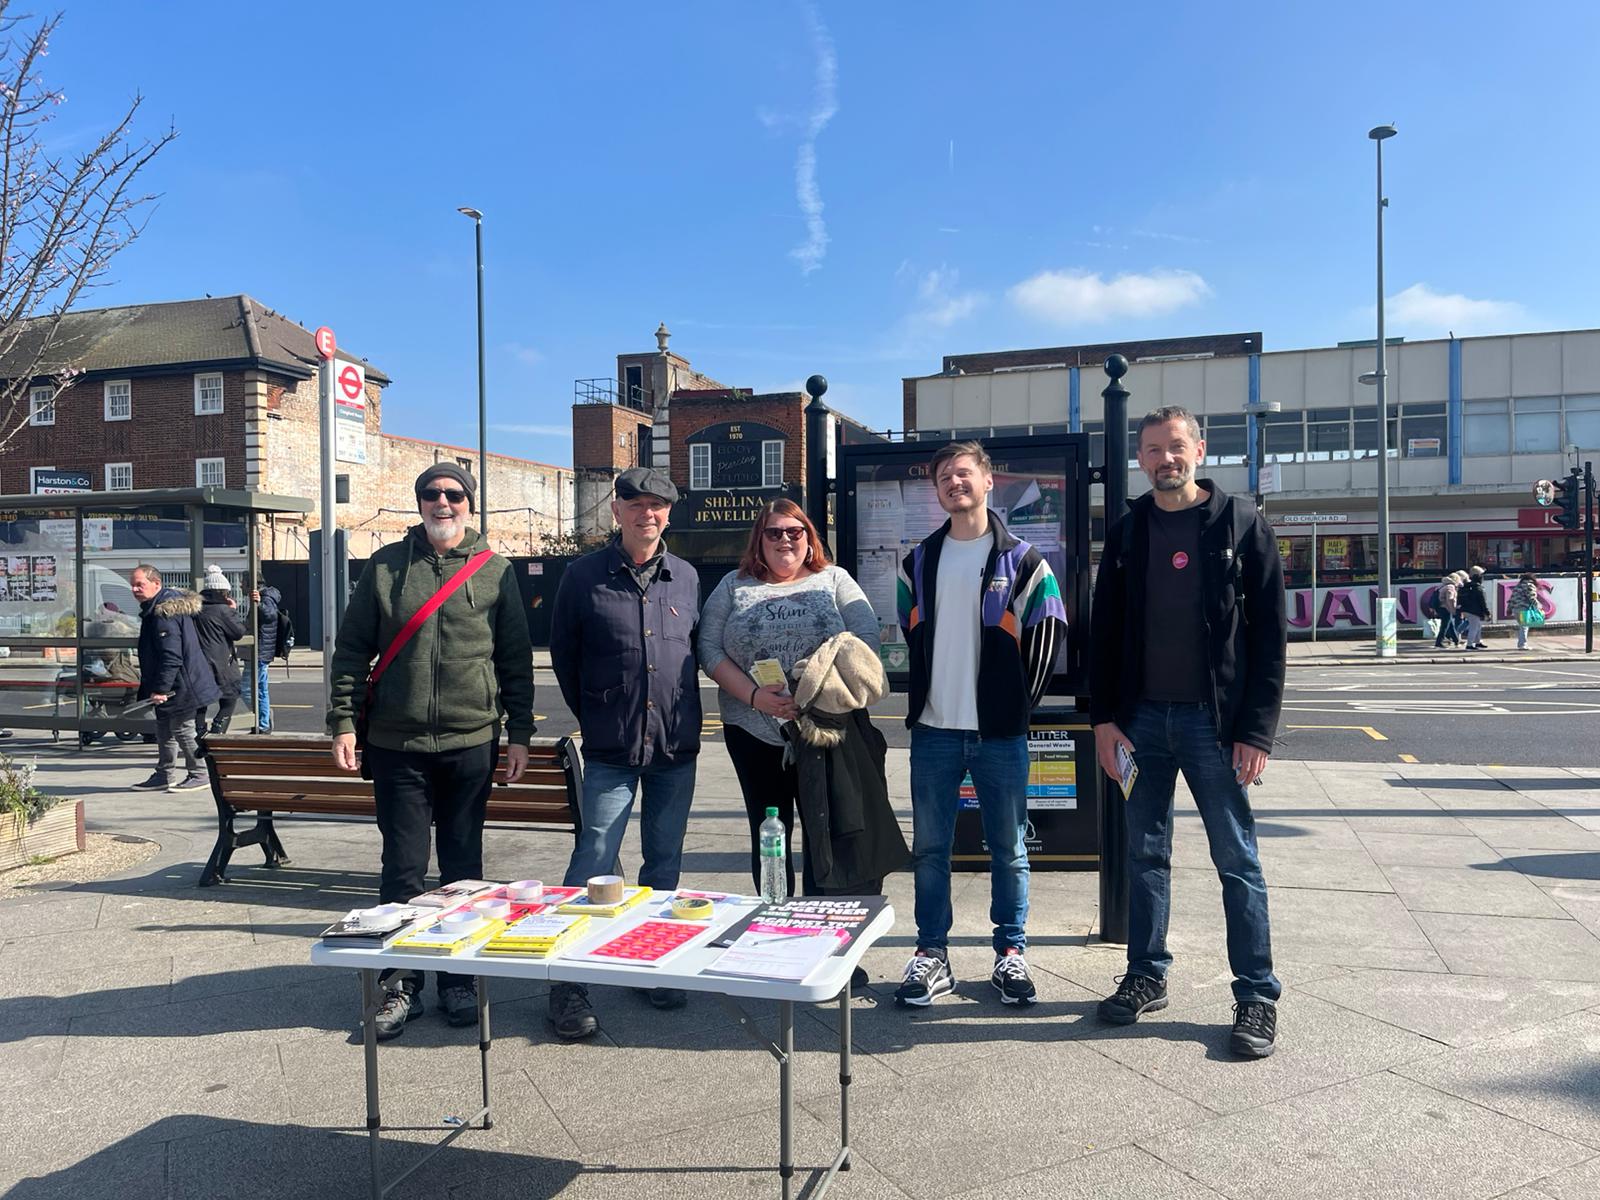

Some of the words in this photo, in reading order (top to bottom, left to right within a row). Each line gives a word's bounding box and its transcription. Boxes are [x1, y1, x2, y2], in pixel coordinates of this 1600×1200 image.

[321, 331, 332, 353] E
[729, 432, 743, 440] 1970
[704, 496, 765, 508] SHELINA
[695, 510, 757, 522] JEWELLE
[1417, 540, 1440, 551] FREE
[766, 604, 809, 621] Shine
[1030, 730, 1069, 740] LITTER
[784, 900, 862, 909] MARCH
[768, 905, 870, 915] TOGETHER
[751, 917, 826, 927] AGAINST
